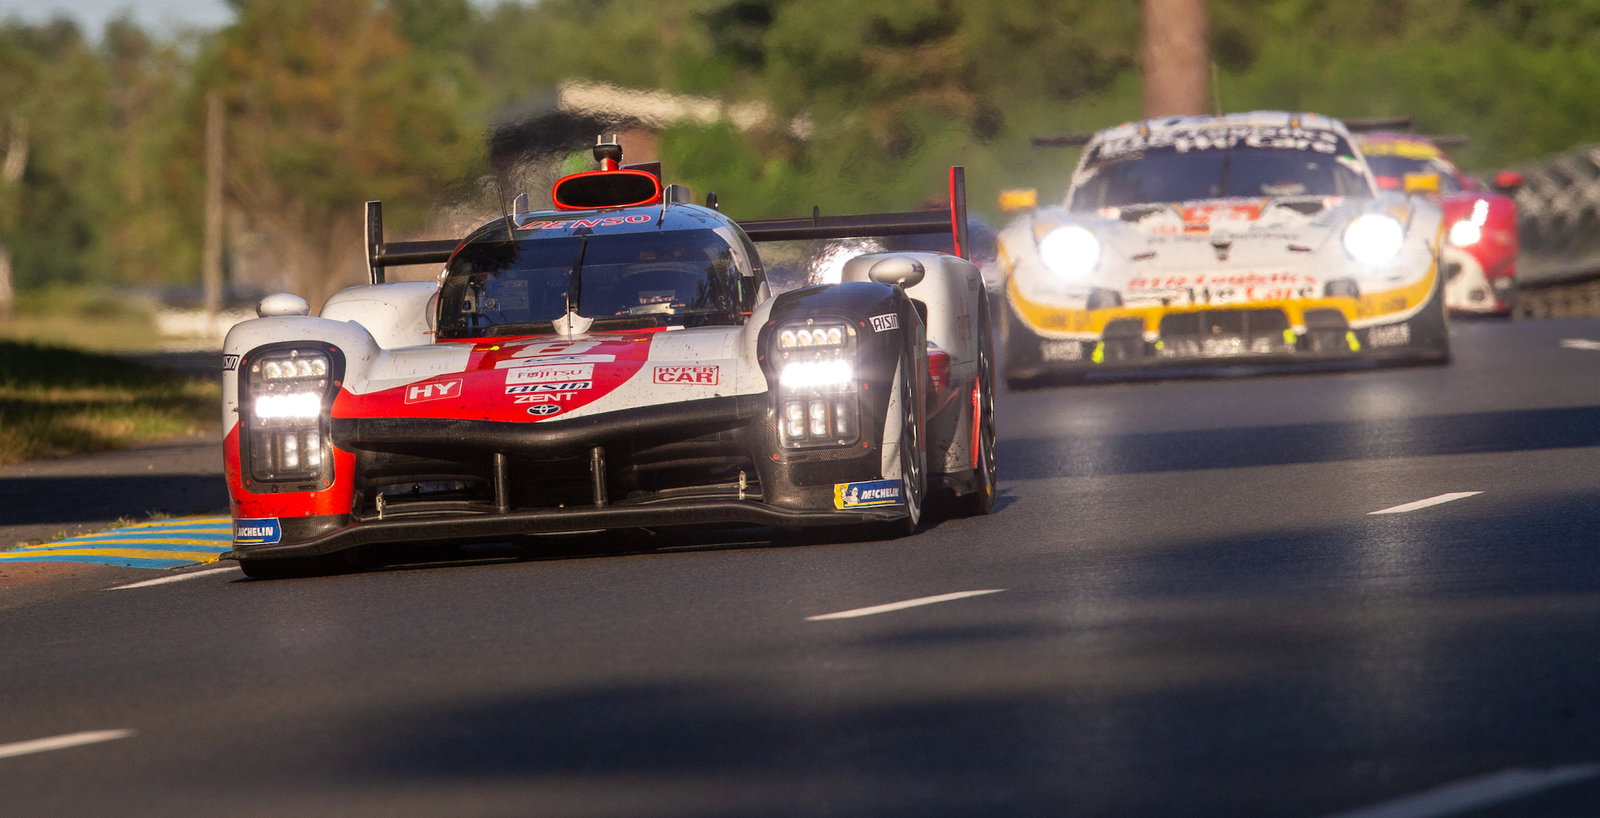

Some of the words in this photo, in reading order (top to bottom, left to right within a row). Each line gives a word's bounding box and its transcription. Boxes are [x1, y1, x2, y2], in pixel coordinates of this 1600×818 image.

[517, 214, 651, 230] DENSO
[873, 314, 897, 330] AISIN
[517, 368, 582, 379] FUJITSU
[658, 373, 713, 383] CAR
[409, 382, 457, 399] HY
[507, 382, 590, 394] AISIN
[514, 392, 577, 404] ZENT
[861, 487, 899, 499] MICHELIN
